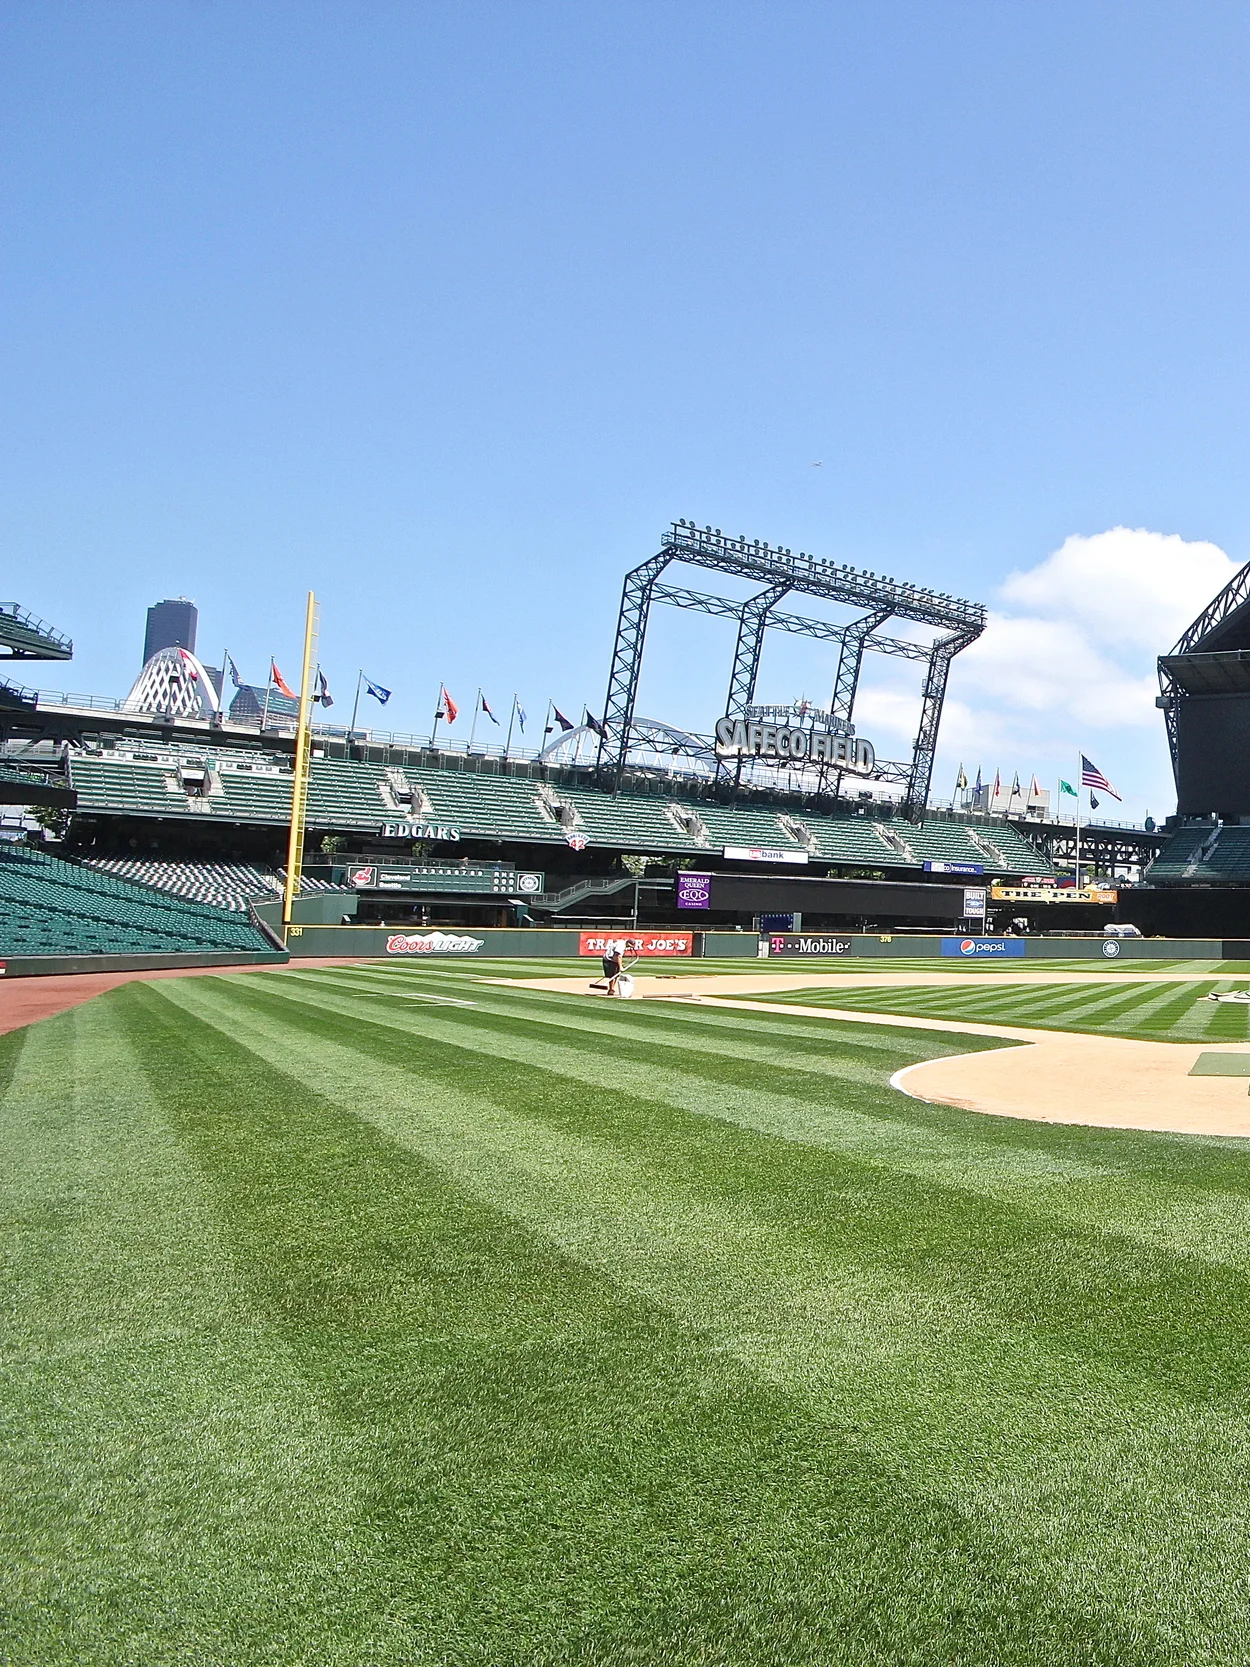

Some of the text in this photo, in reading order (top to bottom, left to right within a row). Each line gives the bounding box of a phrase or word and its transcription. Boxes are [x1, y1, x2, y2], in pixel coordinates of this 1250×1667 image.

[746, 704, 790, 718] SEATTLE
[716, 717, 876, 775] SAFECO FIELD
[966, 892, 984, 900] BUILT
[1001, 890, 1042, 898] THE
[290, 928, 302, 936] 331
[388, 935, 484, 952] Coors LIGHT
[586, 939, 688, 951] TRAR JOE'S
[976, 942, 1006, 953] pepsi
